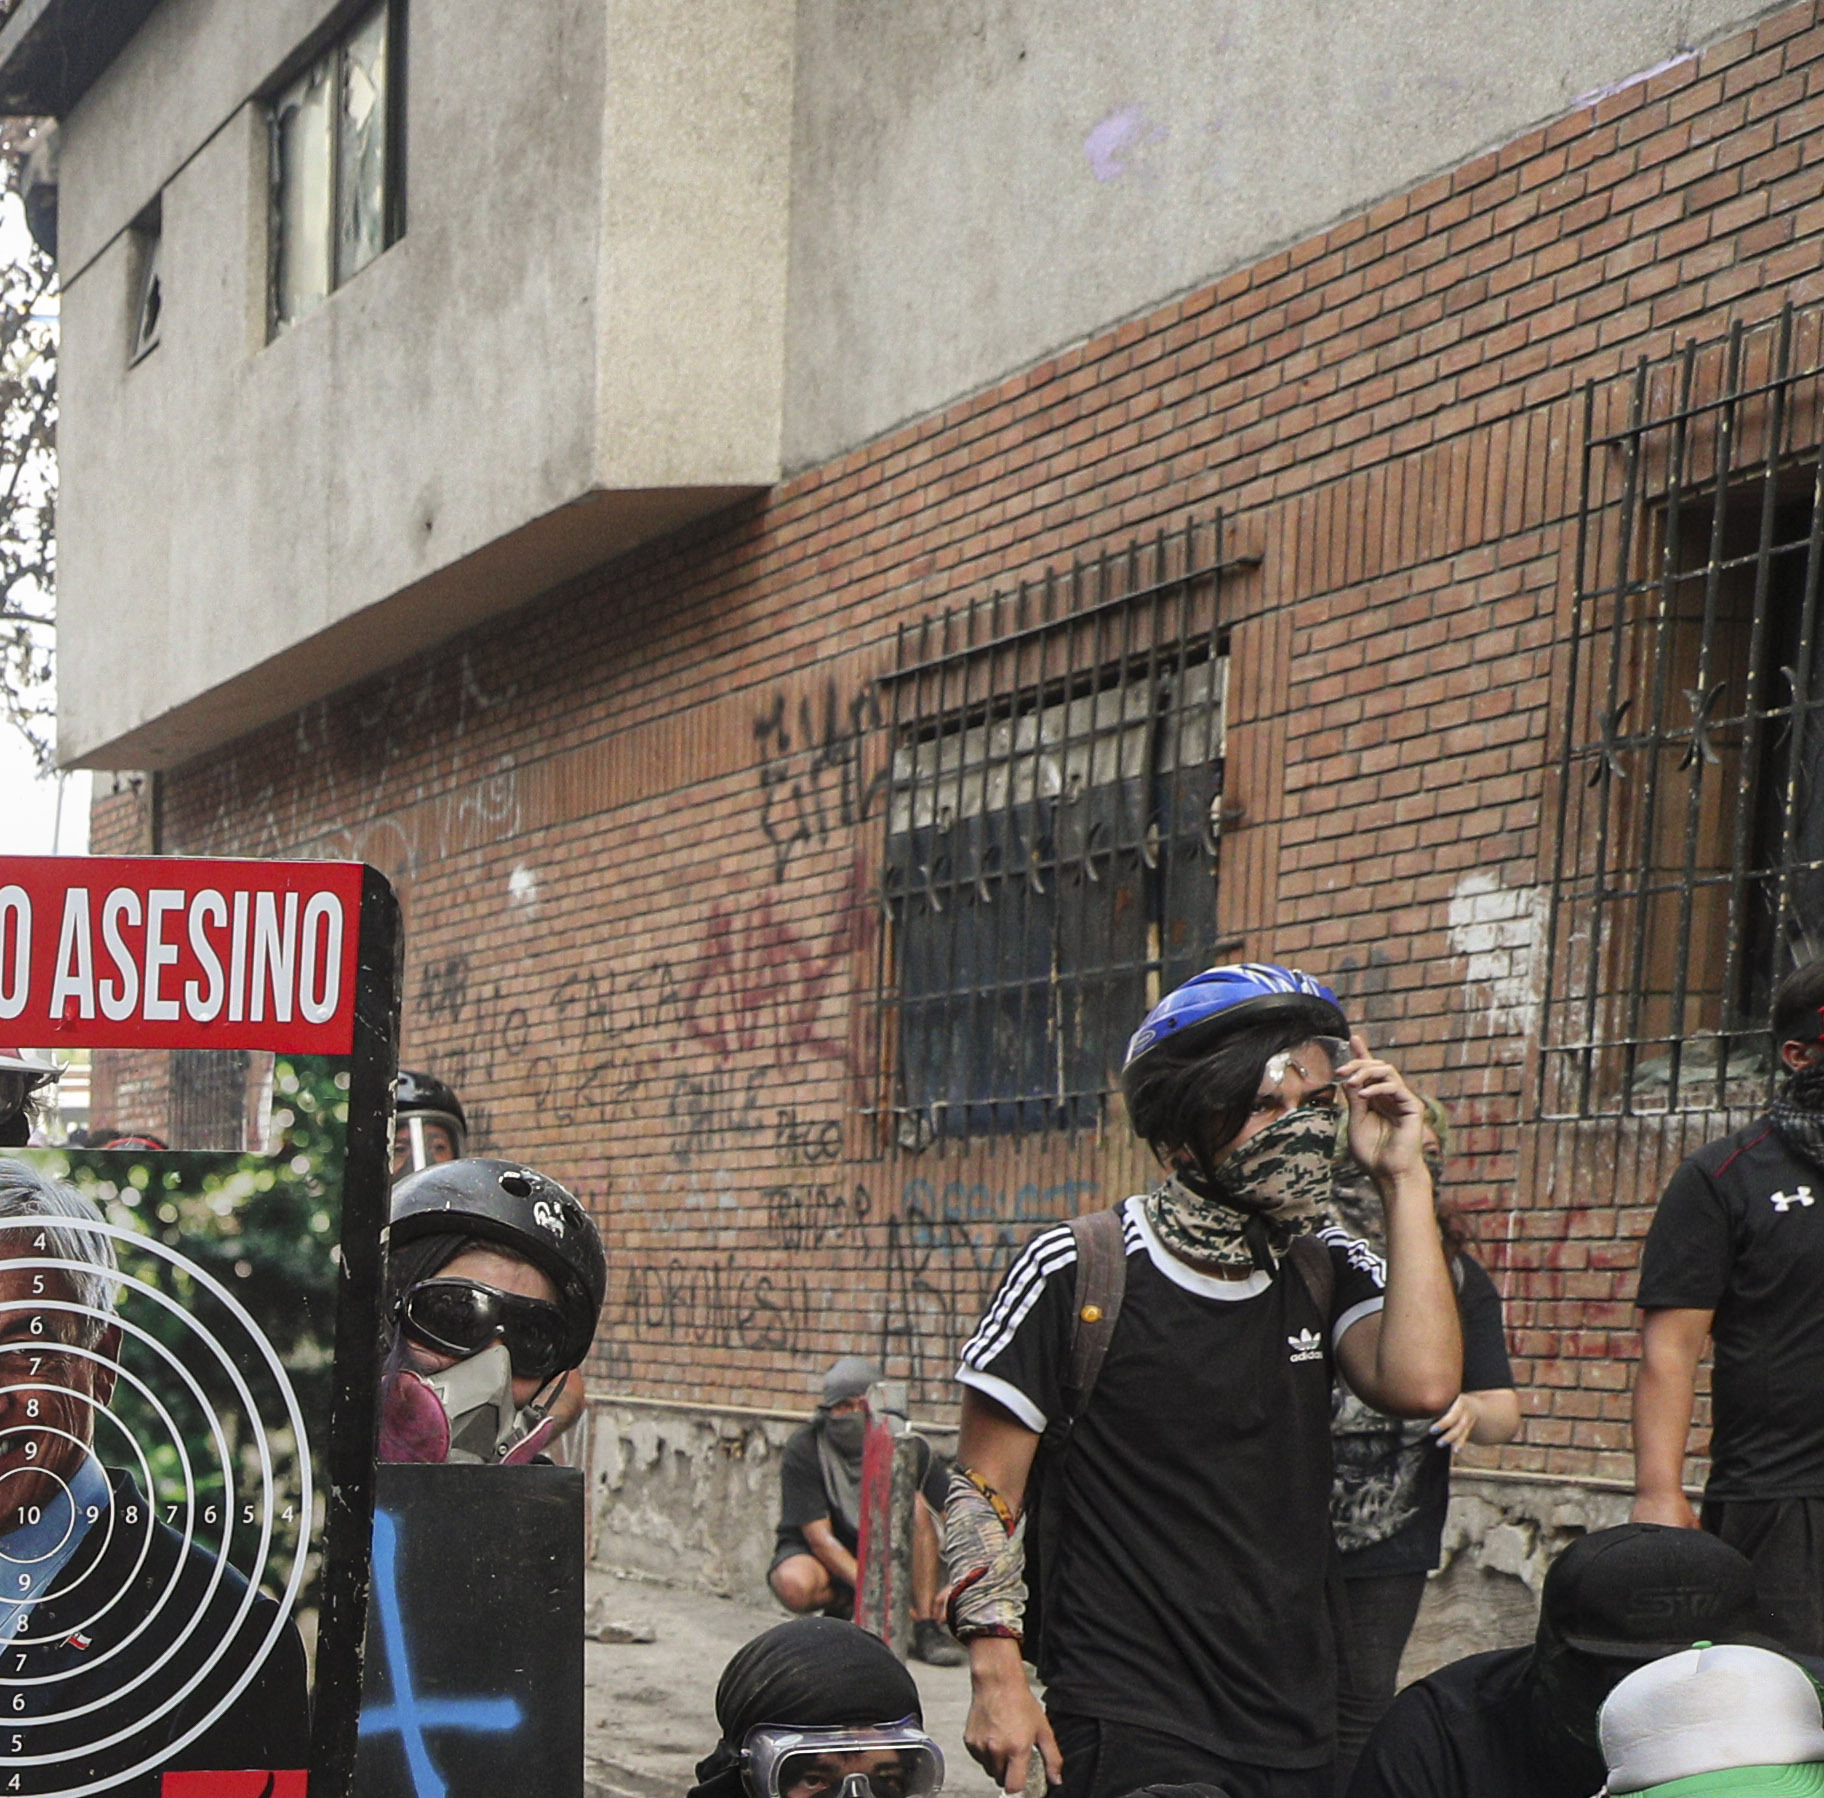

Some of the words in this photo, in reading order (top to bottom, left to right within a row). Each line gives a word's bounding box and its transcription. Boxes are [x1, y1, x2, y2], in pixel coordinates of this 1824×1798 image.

[48, 886, 345, 1026] ASESINO
[33, 1232, 46, 1250] 4
[32, 1275, 44, 1294] 5
[30, 1316, 43, 1335] 6
[30, 1357, 41, 1376] 7
[26, 1398, 39, 1418] 8
[25, 1441, 38, 1460] 9
[18, 1506, 40, 1525] 10
[86, 1505, 99, 1524] 9
[125, 1505, 138, 1524] 8
[166, 1505, 178, 1524] 7
[204, 1505, 217, 1524] 6
[243, 1505, 254, 1524] 5
[281, 1505, 293, 1523] 4
[18, 1573, 31, 1592] 9
[16, 1614, 29, 1632] 8
[16, 1654, 27, 1672] 7
[12, 1693, 25, 1711] 6
[11, 1734, 22, 1752] 5
[8, 1773, 20, 1790] 4
